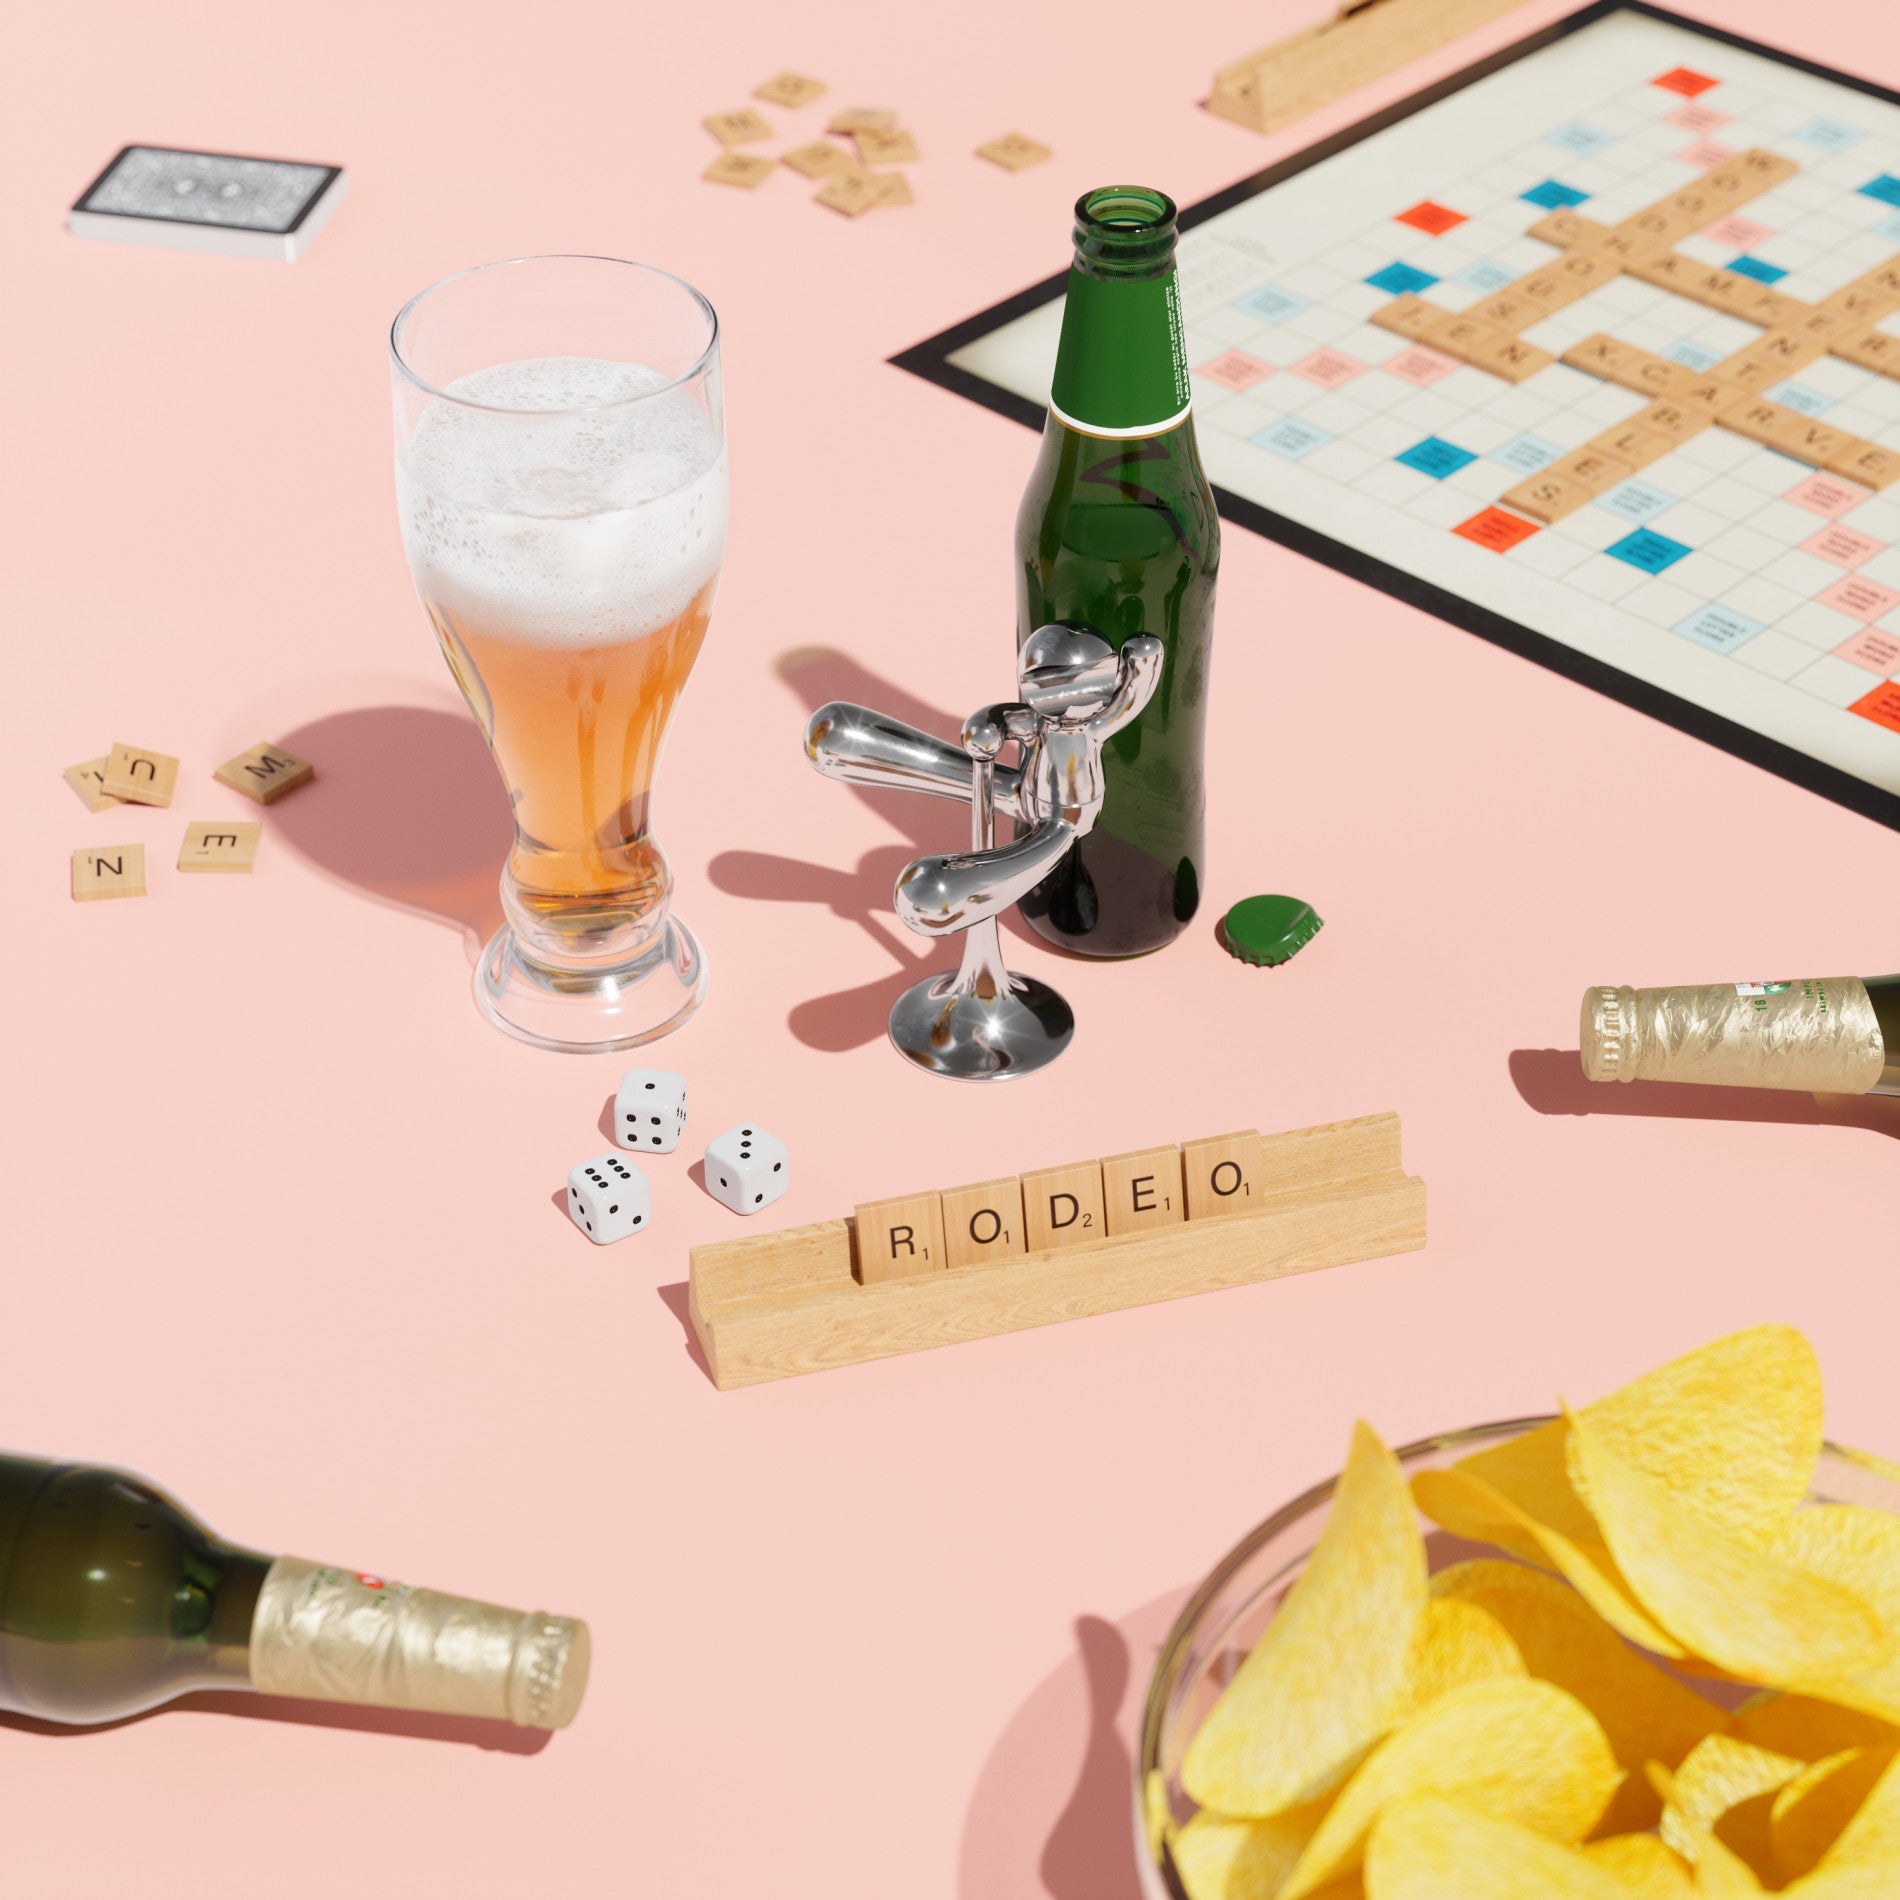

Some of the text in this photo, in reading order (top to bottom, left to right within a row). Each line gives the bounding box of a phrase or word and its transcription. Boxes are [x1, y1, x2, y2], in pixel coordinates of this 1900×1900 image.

[130, 759, 157, 782] U
[244, 755, 286, 781] M
[202, 833, 237, 848] E
